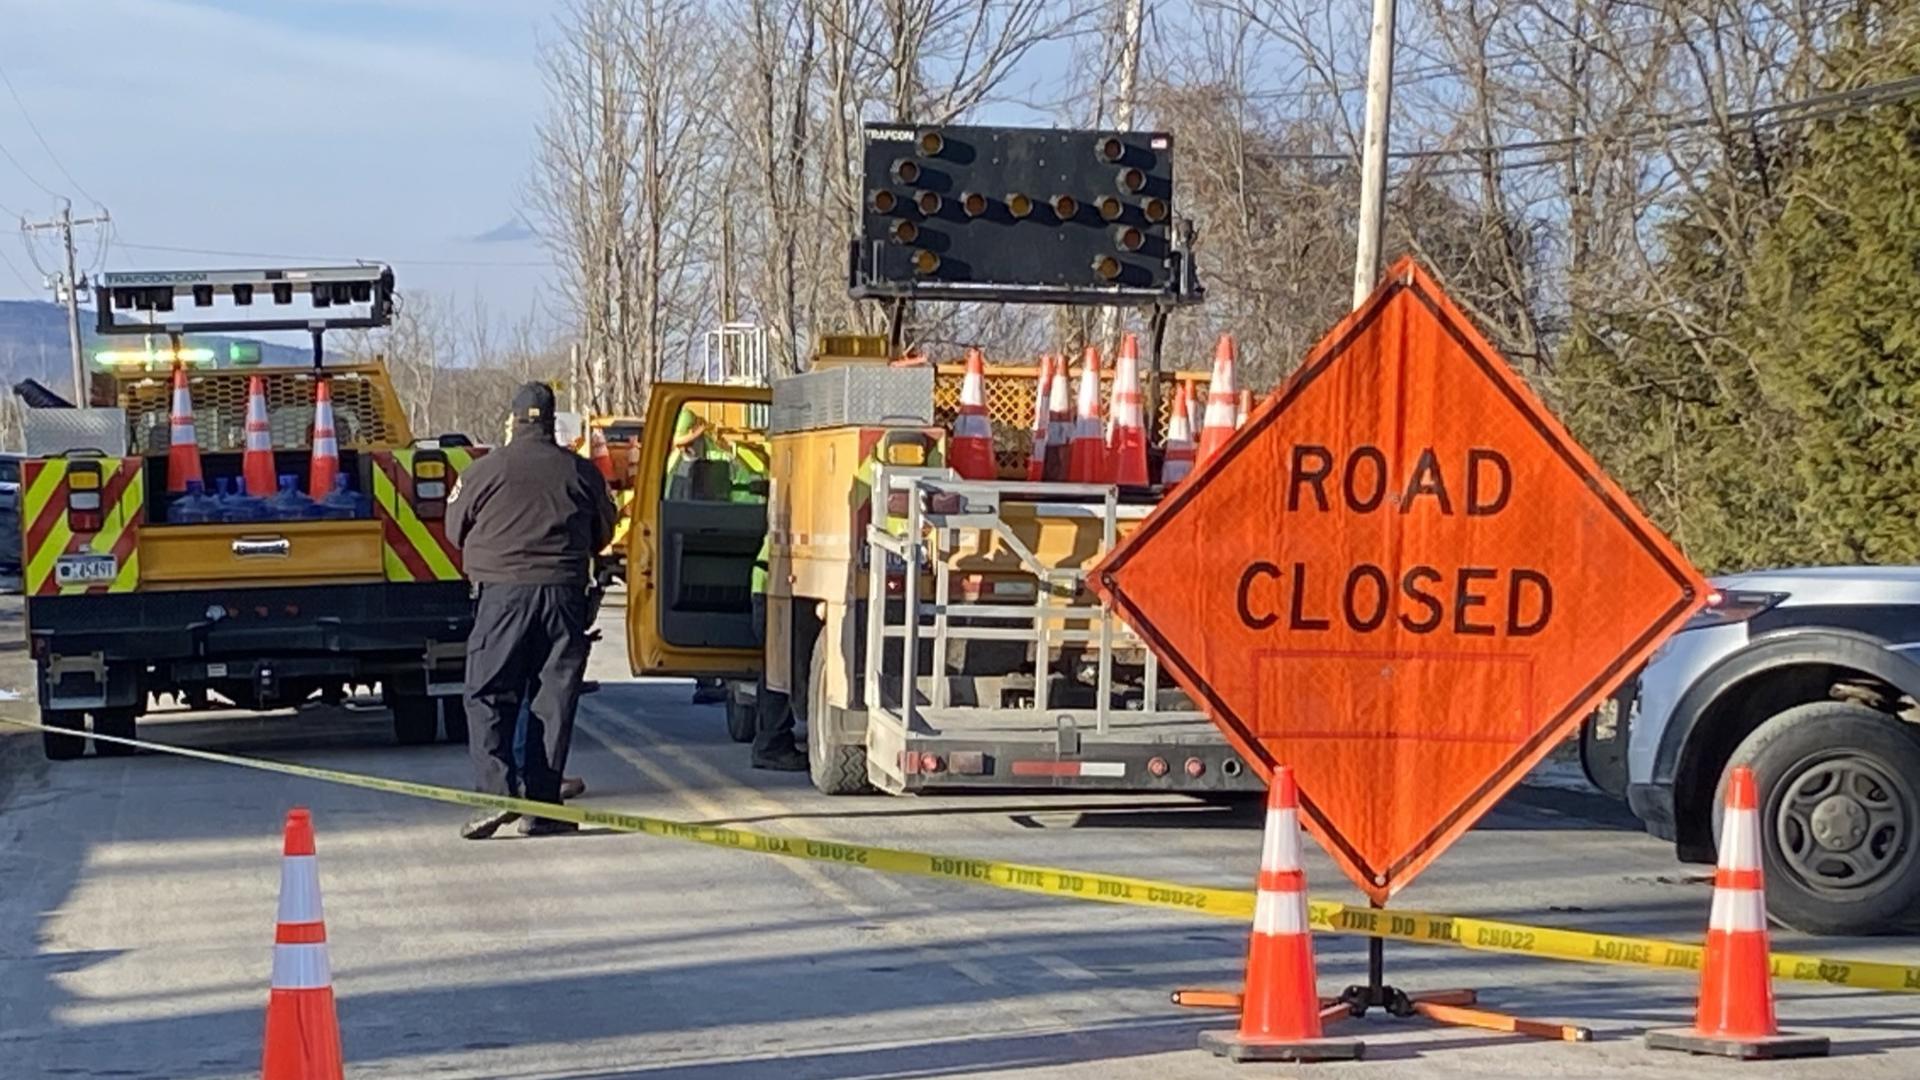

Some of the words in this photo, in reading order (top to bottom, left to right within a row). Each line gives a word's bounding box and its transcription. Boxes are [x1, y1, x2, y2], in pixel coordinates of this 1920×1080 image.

[864, 129, 915, 141] TRAFCON
[1287, 444, 1513, 516] ROAD
[1237, 561, 1553, 637] CLOSED
